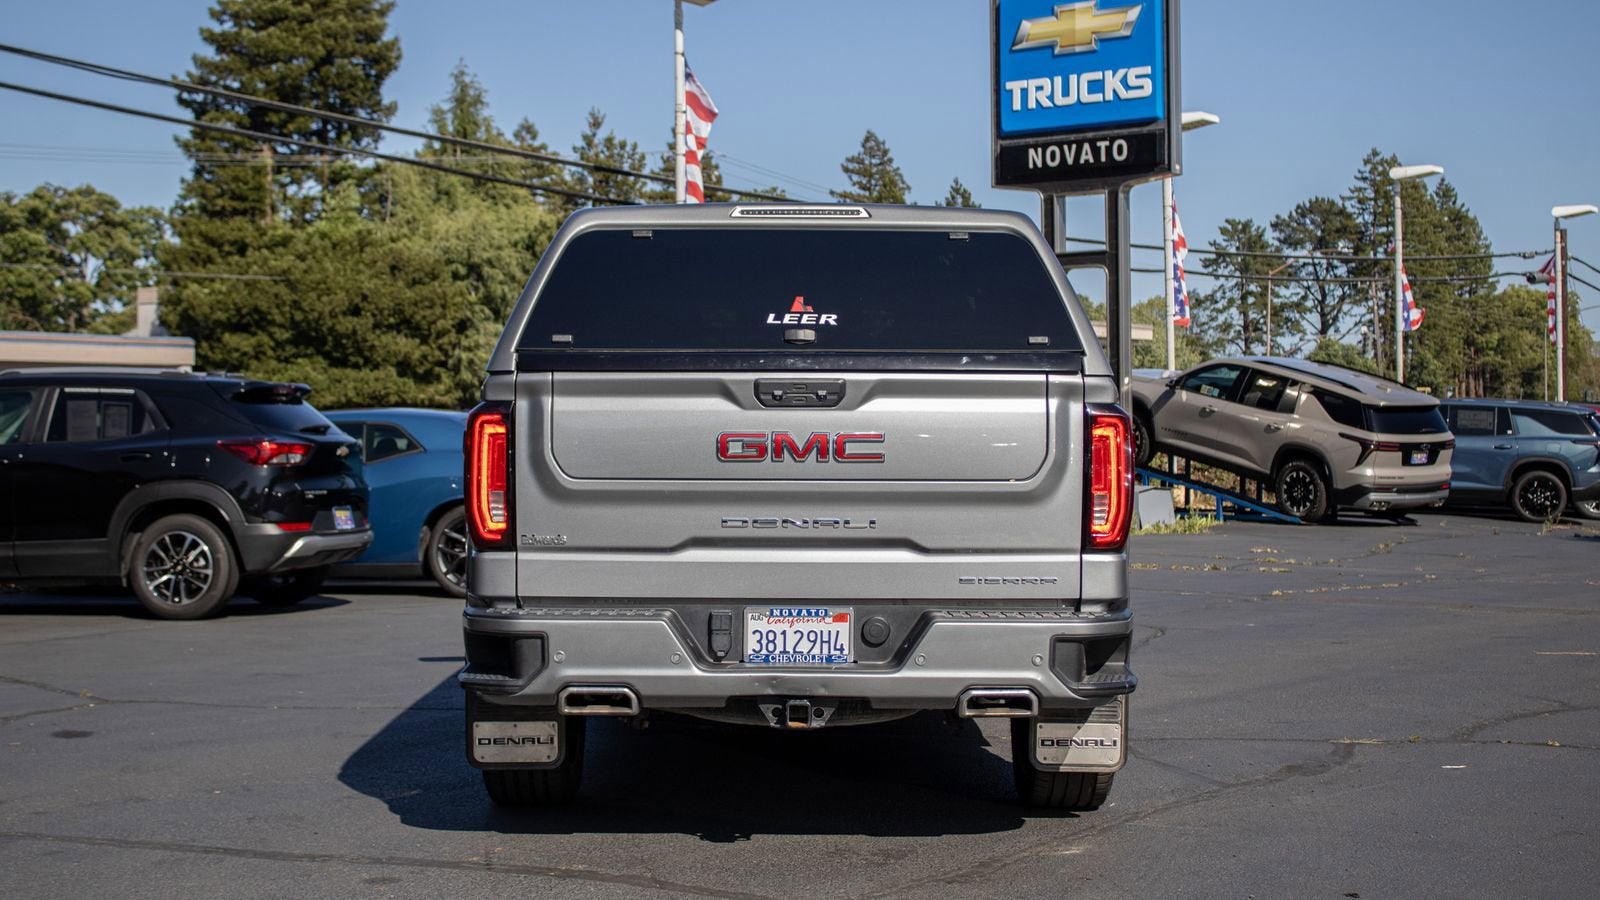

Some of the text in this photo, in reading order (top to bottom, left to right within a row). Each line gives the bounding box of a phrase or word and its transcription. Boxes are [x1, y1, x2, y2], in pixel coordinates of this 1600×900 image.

[1005, 65, 1153, 111] TRUCKS
[1028, 138, 1128, 169] NOVATO
[766, 313, 838, 325] LEER
[716, 431, 885, 463] GMC
[721, 517, 876, 529] DENALI
[959, 577, 1058, 585] SIERRA
[766, 616, 833, 628] California
[752, 629, 845, 654] 38129H4
[769, 655, 827, 663] CHEVROLET
[478, 737, 554, 746] DENALI
[1040, 738, 1117, 748] DENALI
